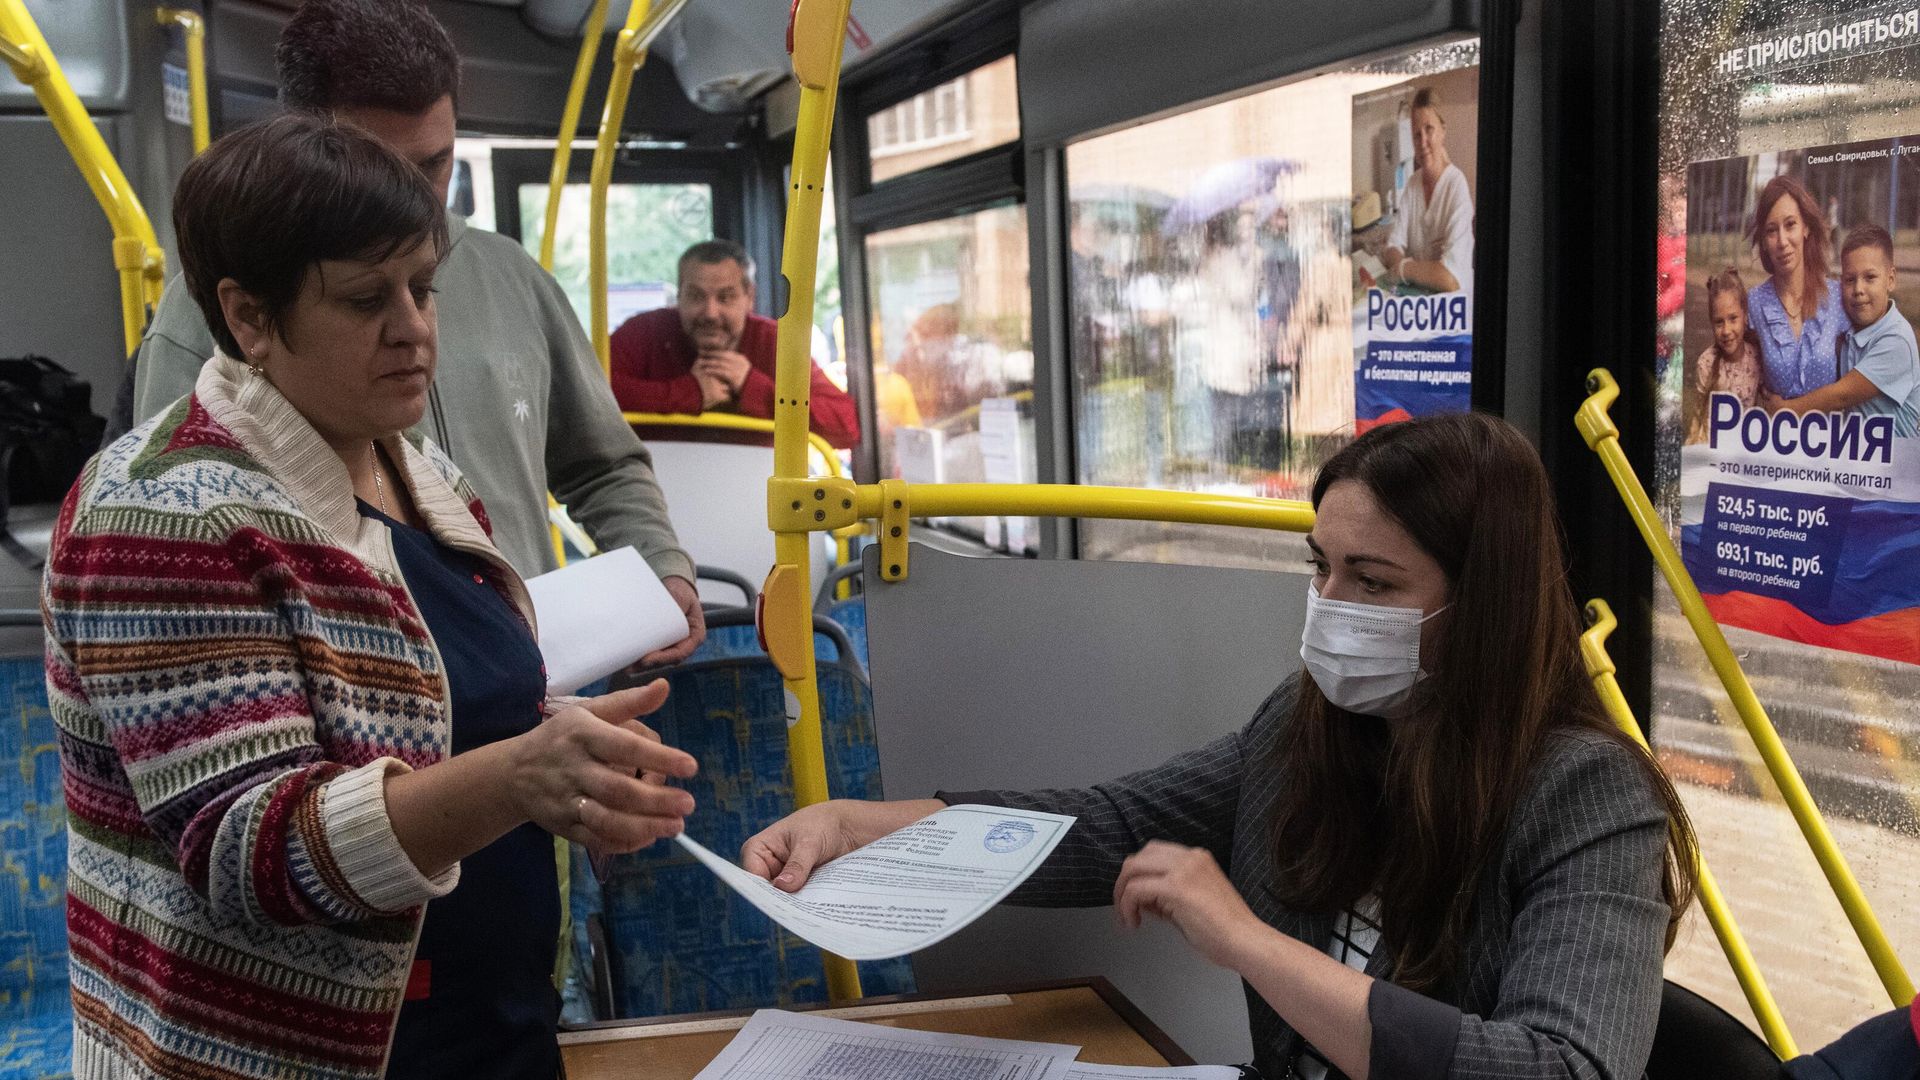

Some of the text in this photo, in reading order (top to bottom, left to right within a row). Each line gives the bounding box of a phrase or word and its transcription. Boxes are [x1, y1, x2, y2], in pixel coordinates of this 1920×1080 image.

[1719, 9, 1919, 74] НЕ ПРИСЛОНЯТЬСЯ
[1808, 155, 1834, 164] Семья
[1835, 149, 1889, 162] Свиридовых,
[1368, 289, 1467, 331] Россия
[1378, 350, 1392, 362] это
[1393, 350, 1456, 363] качественная
[1364, 365, 1472, 386] и бесплатная медицина
[1709, 394, 1894, 464] Россия
[1719, 462, 1740, 474] это
[1743, 465, 1831, 483] материнский
[1835, 472, 1892, 489] капитал
[1717, 496, 1830, 529] 524,5 тыс. руб.
[1717, 522, 1807, 541] на первого ребенка
[1717, 541, 1824, 577] 693,1 тыс. руб.
[1717, 567, 1801, 589] на второго ребенка
